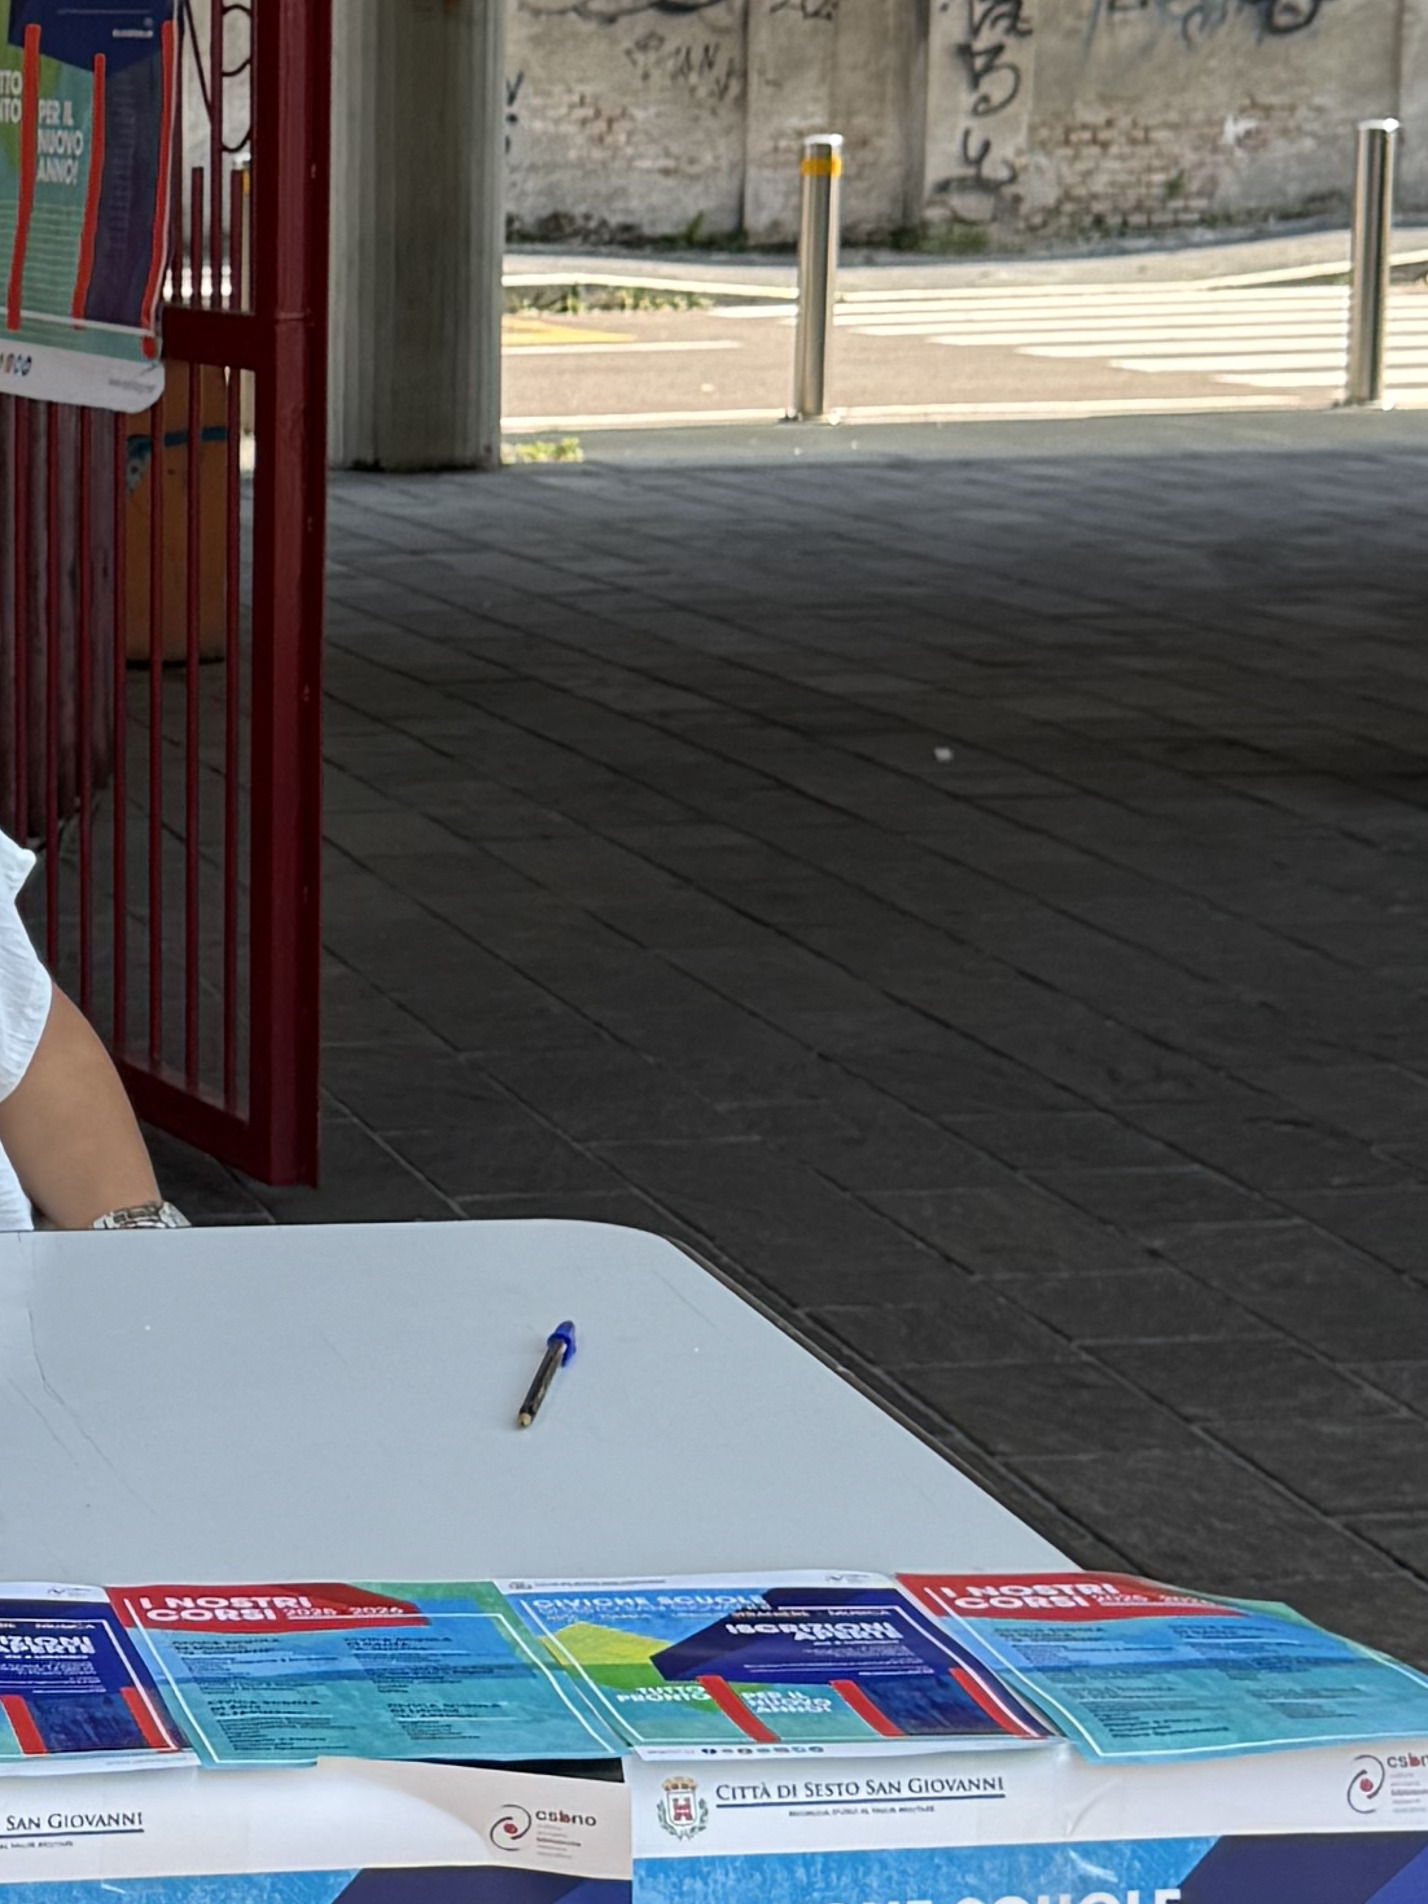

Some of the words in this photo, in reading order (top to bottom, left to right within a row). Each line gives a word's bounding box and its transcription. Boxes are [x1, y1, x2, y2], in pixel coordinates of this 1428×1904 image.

[139, 1598, 152, 1609] I
[164, 1596, 312, 1609] NOSTRI
[147, 1608, 276, 1621] CORSI
